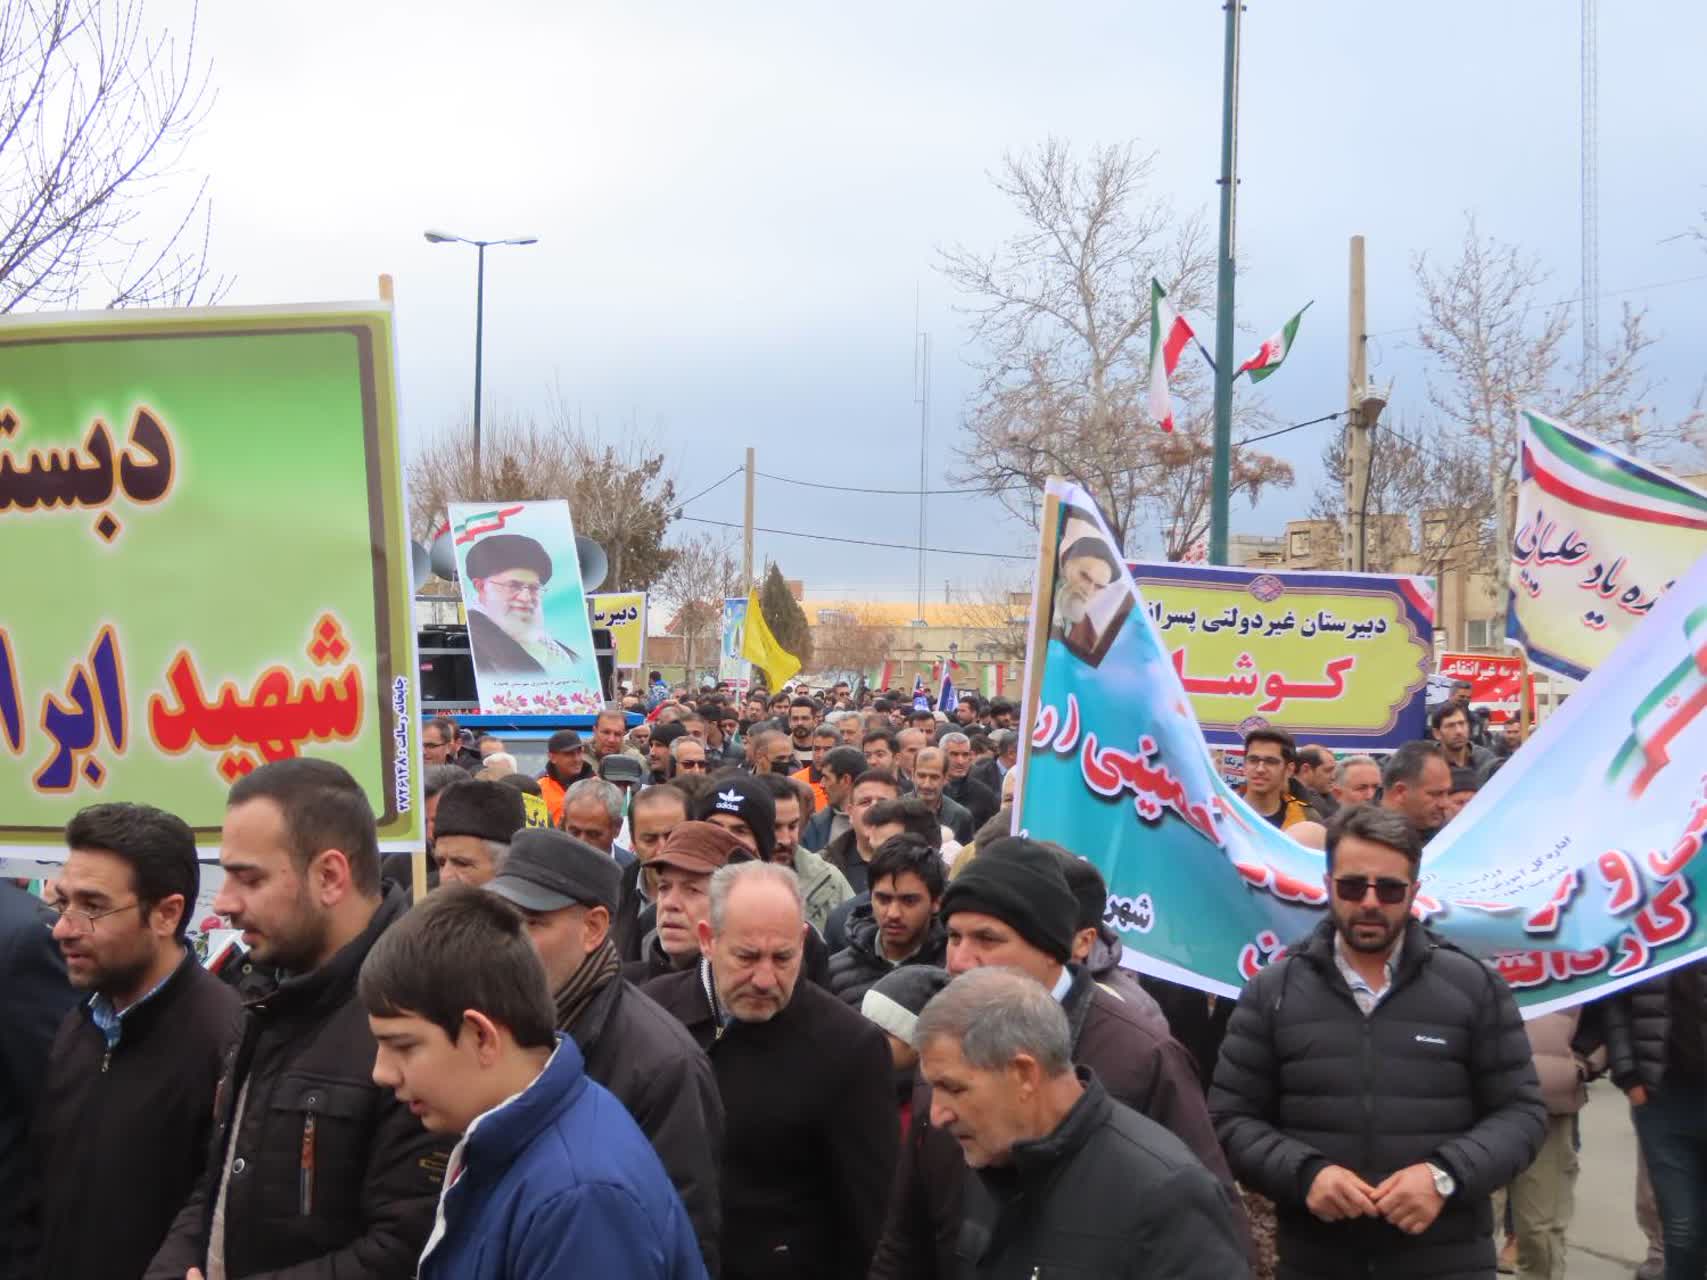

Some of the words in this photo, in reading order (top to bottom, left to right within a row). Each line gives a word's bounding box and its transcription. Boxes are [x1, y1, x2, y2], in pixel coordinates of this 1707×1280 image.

[1301, 613, 1387, 639] دبیرستان
[151, 617, 362, 780] شهید
[716, 802, 739, 811] adidas
